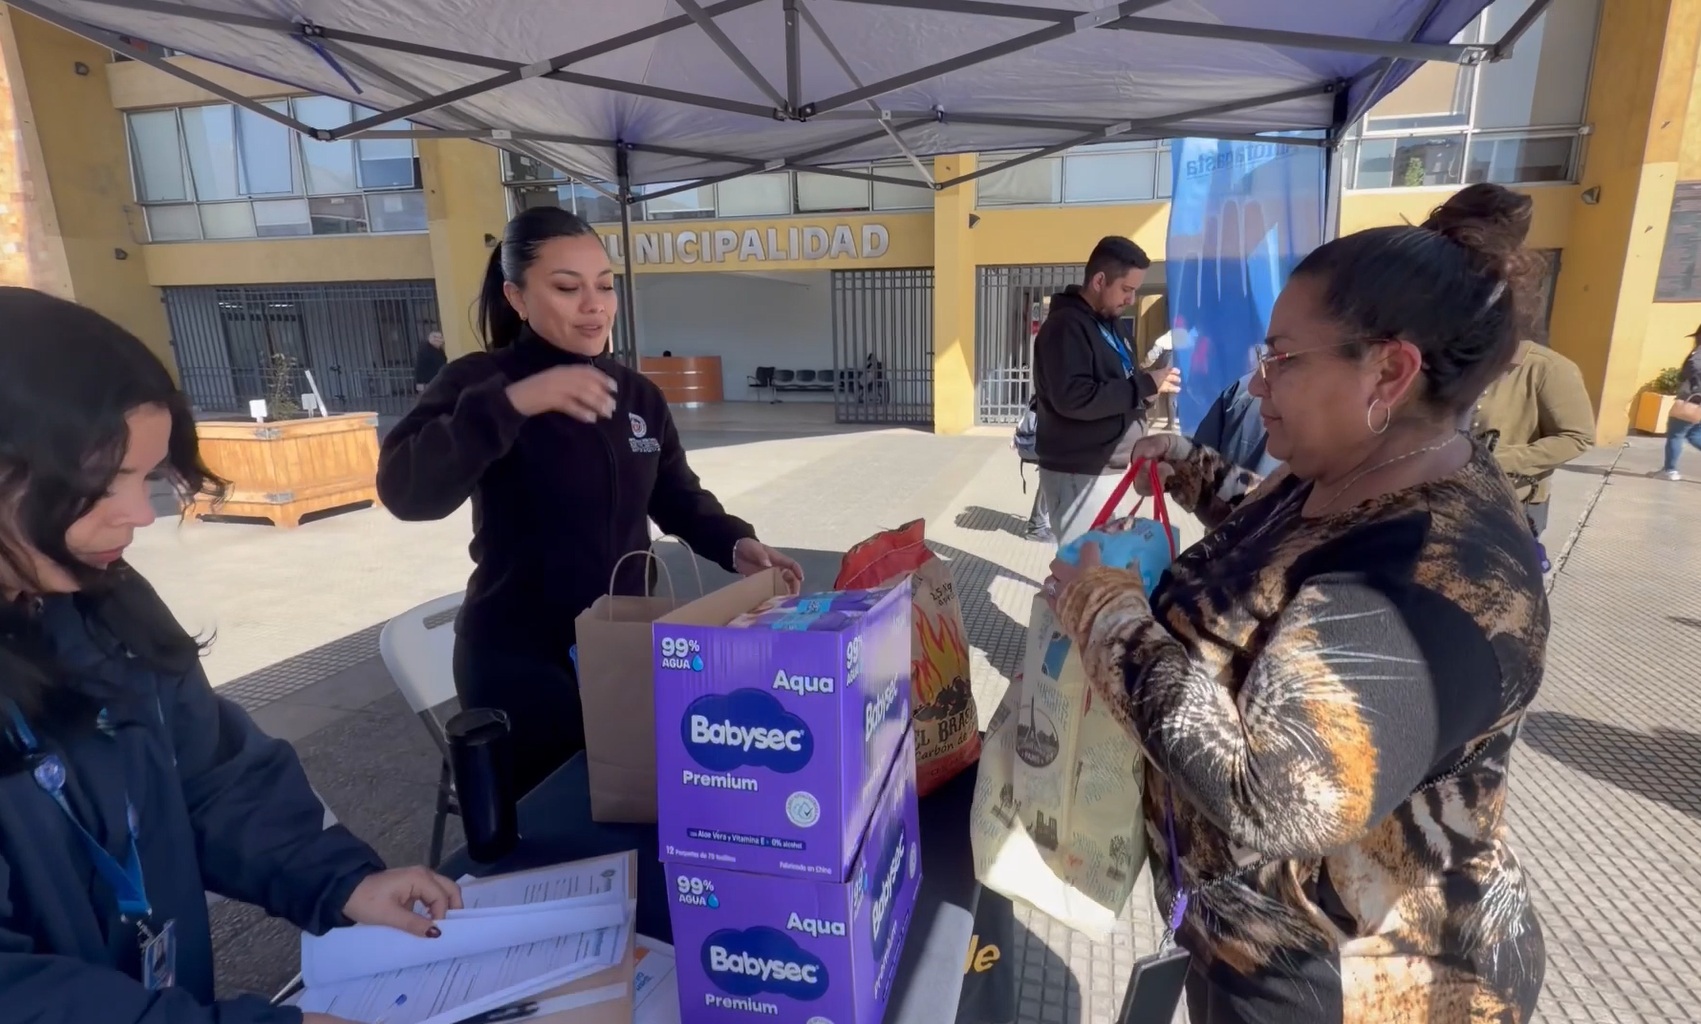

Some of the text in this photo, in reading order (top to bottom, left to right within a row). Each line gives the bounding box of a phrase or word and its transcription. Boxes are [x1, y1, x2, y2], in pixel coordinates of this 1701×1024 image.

[599, 224, 891, 267] UNICIPALIDAD
[661, 636, 700, 659] 99%
[661, 656, 691, 670] AGUA
[772, 669, 835, 696] Aqua
[690, 714, 804, 752] Babysec
[682, 769, 758, 792] Premium
[698, 829, 711, 839] Aloe
[732, 834, 759, 845] Vitamina
[760, 837, 765, 846] E
[771, 838, 782, 847] 0%
[666, 845, 674, 855] 12
[676, 875, 714, 894] 99%
[872, 831, 905, 942] Babysec
[678, 892, 706, 906] AGUA
[786, 912, 847, 938] Aqua
[709, 944, 819, 984] Babysec
[704, 993, 778, 1015] Premium
